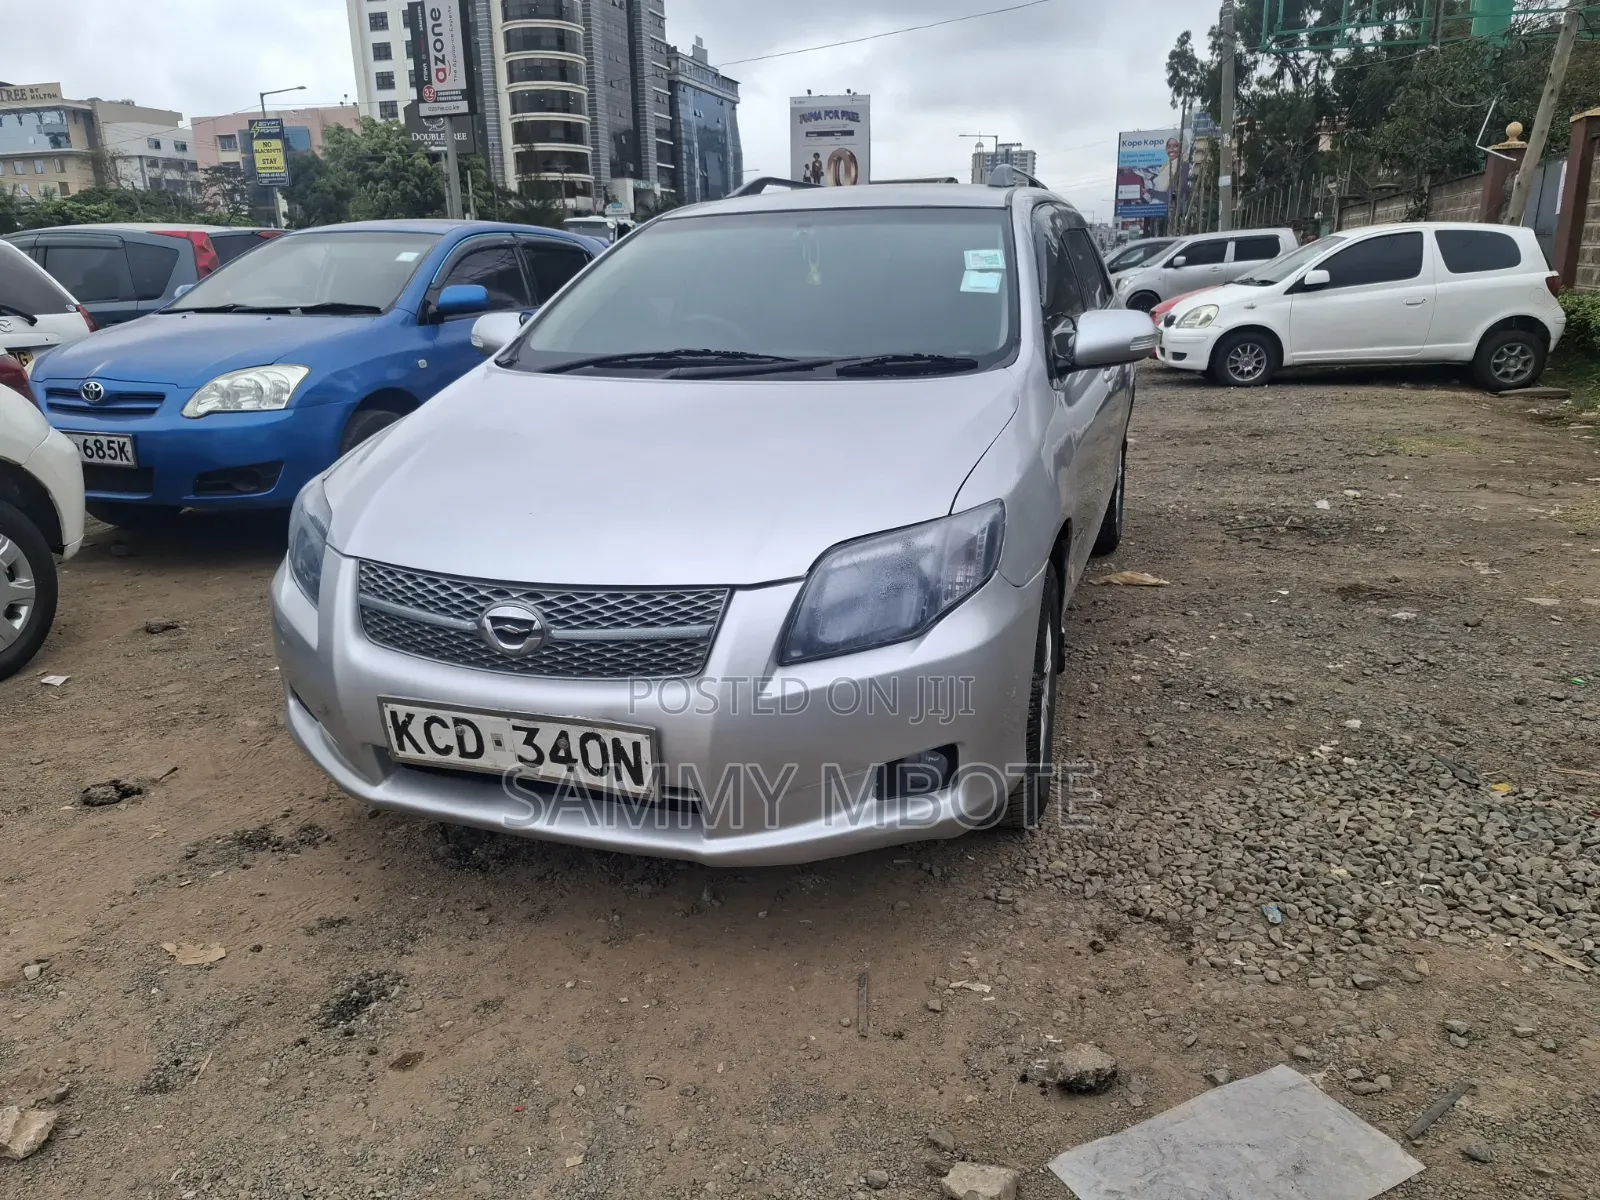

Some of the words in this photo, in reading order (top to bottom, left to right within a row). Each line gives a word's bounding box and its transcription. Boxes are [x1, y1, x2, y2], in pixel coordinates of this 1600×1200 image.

[430, 7, 447, 83] azone
[424, 88, 434, 97] 32
[823, 109, 840, 120] FOR
[1122, 139, 1143, 148] Kopo
[1144, 139, 1164, 147] Kopo
[82, 438, 131, 463] 685K
[389, 709, 485, 760] KCD
[511, 723, 645, 787] 340N
